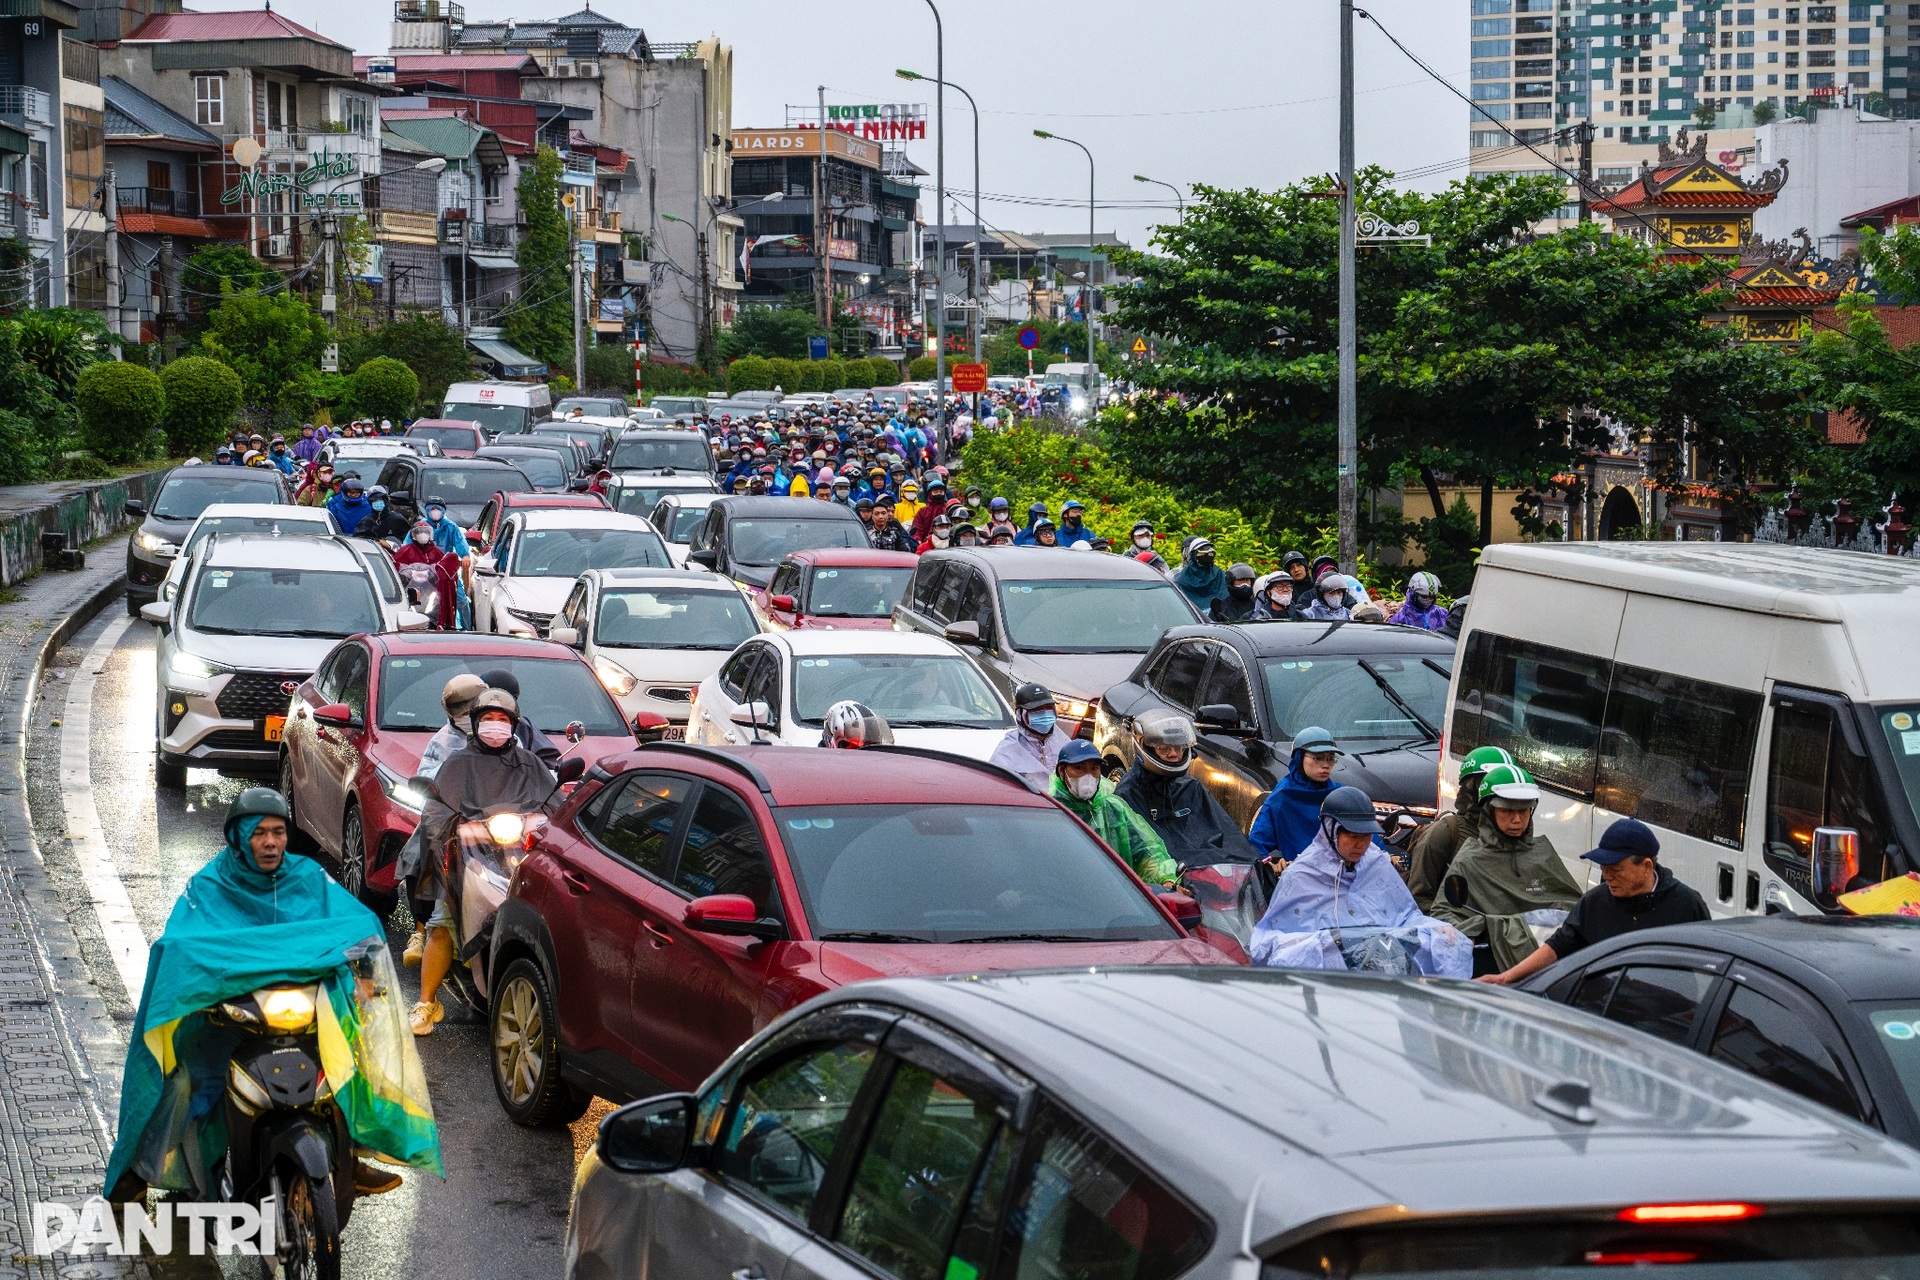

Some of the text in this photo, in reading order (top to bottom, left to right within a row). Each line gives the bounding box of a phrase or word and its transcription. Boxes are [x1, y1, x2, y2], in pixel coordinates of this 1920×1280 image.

[24, 22, 39, 35] 69
[828, 104, 881, 118] HOTEL
[863, 120, 925, 141] NINH
[220, 144, 356, 205] Nam Hải
[302, 193, 360, 207] HOTEL
